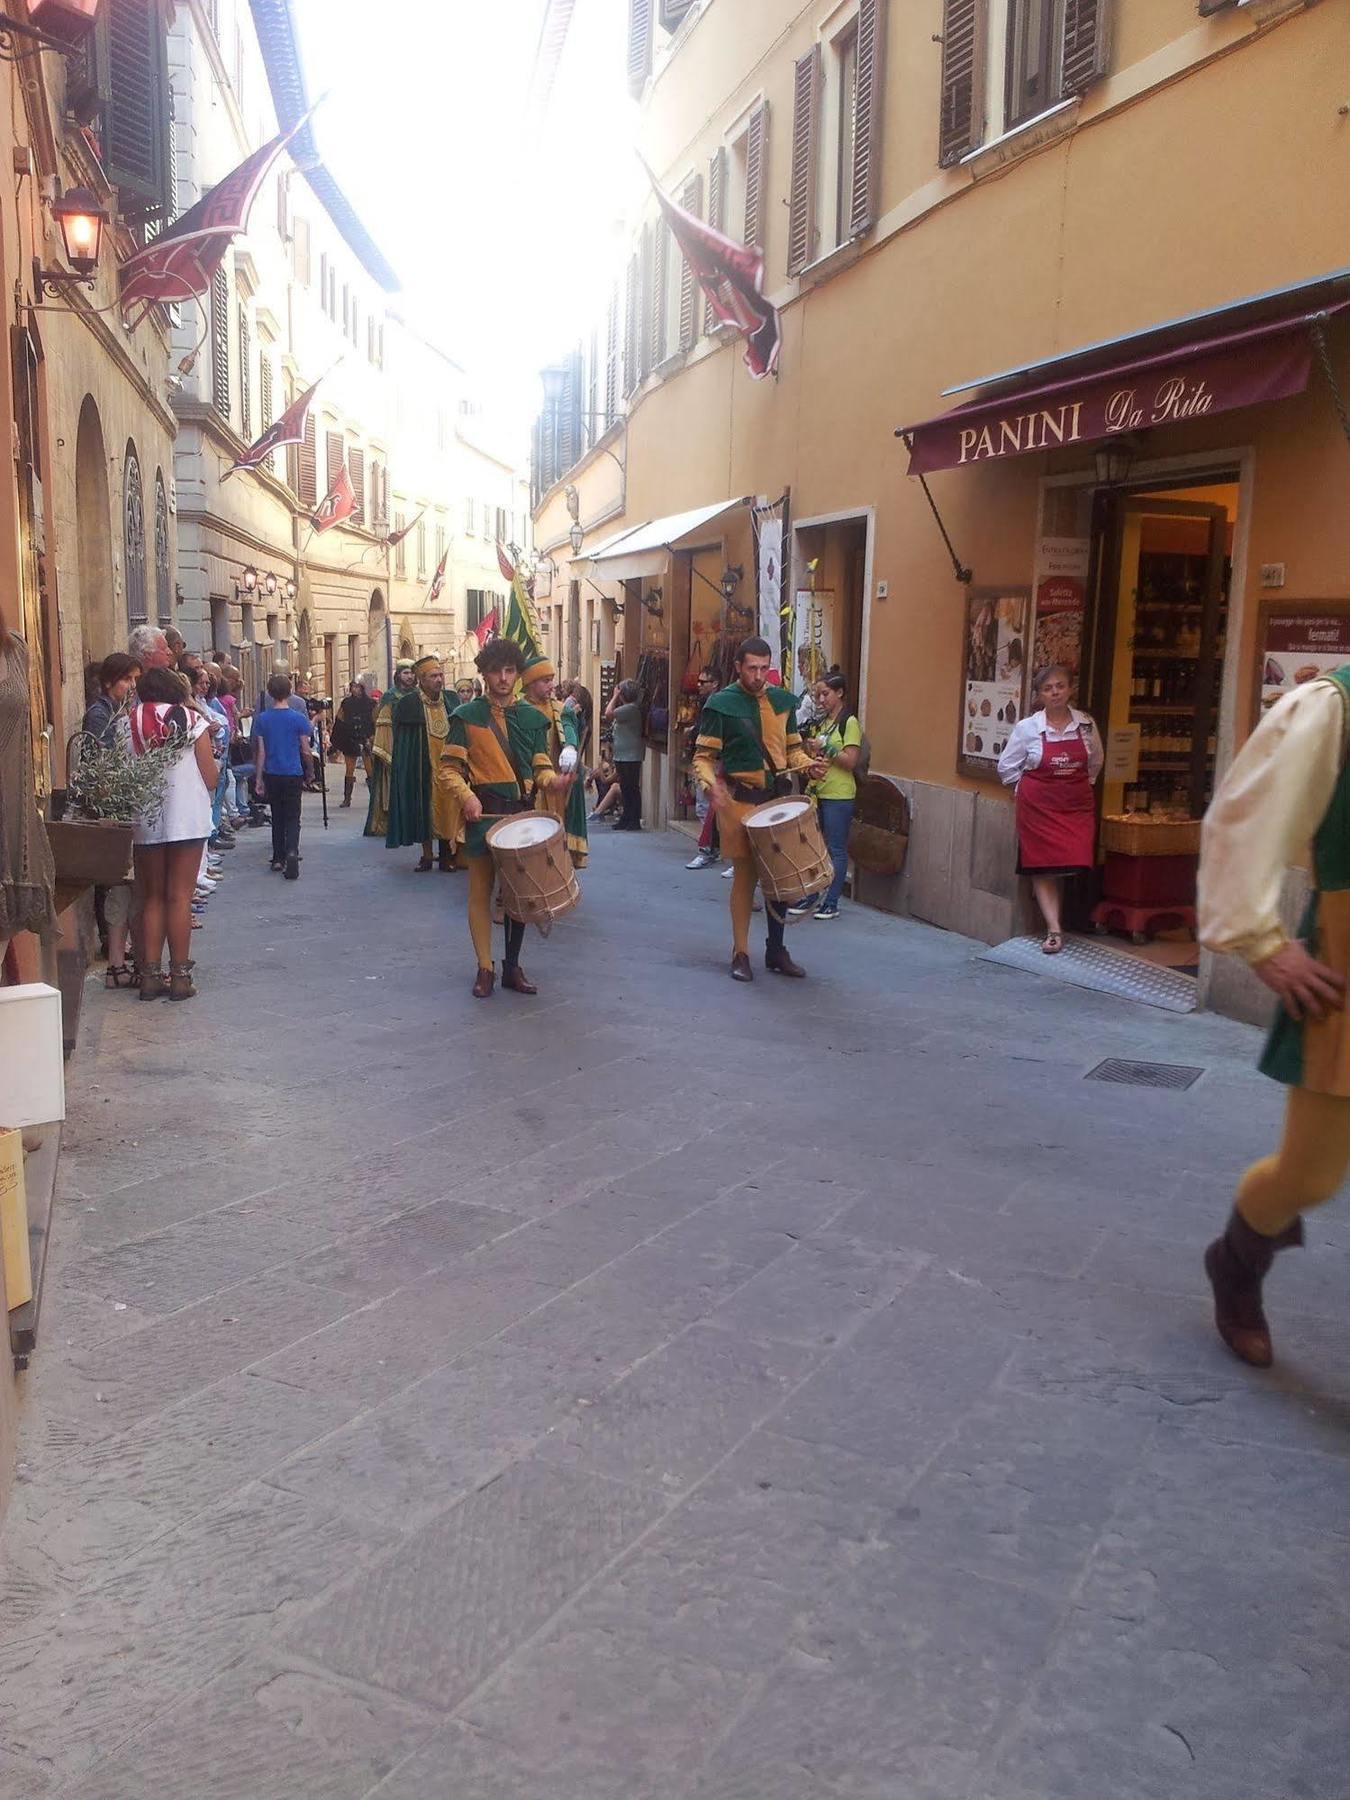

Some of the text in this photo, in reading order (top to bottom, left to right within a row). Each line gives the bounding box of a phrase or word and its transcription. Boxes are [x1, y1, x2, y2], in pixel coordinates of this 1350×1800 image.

[957, 377, 1213, 464] PANINI Da Rita
